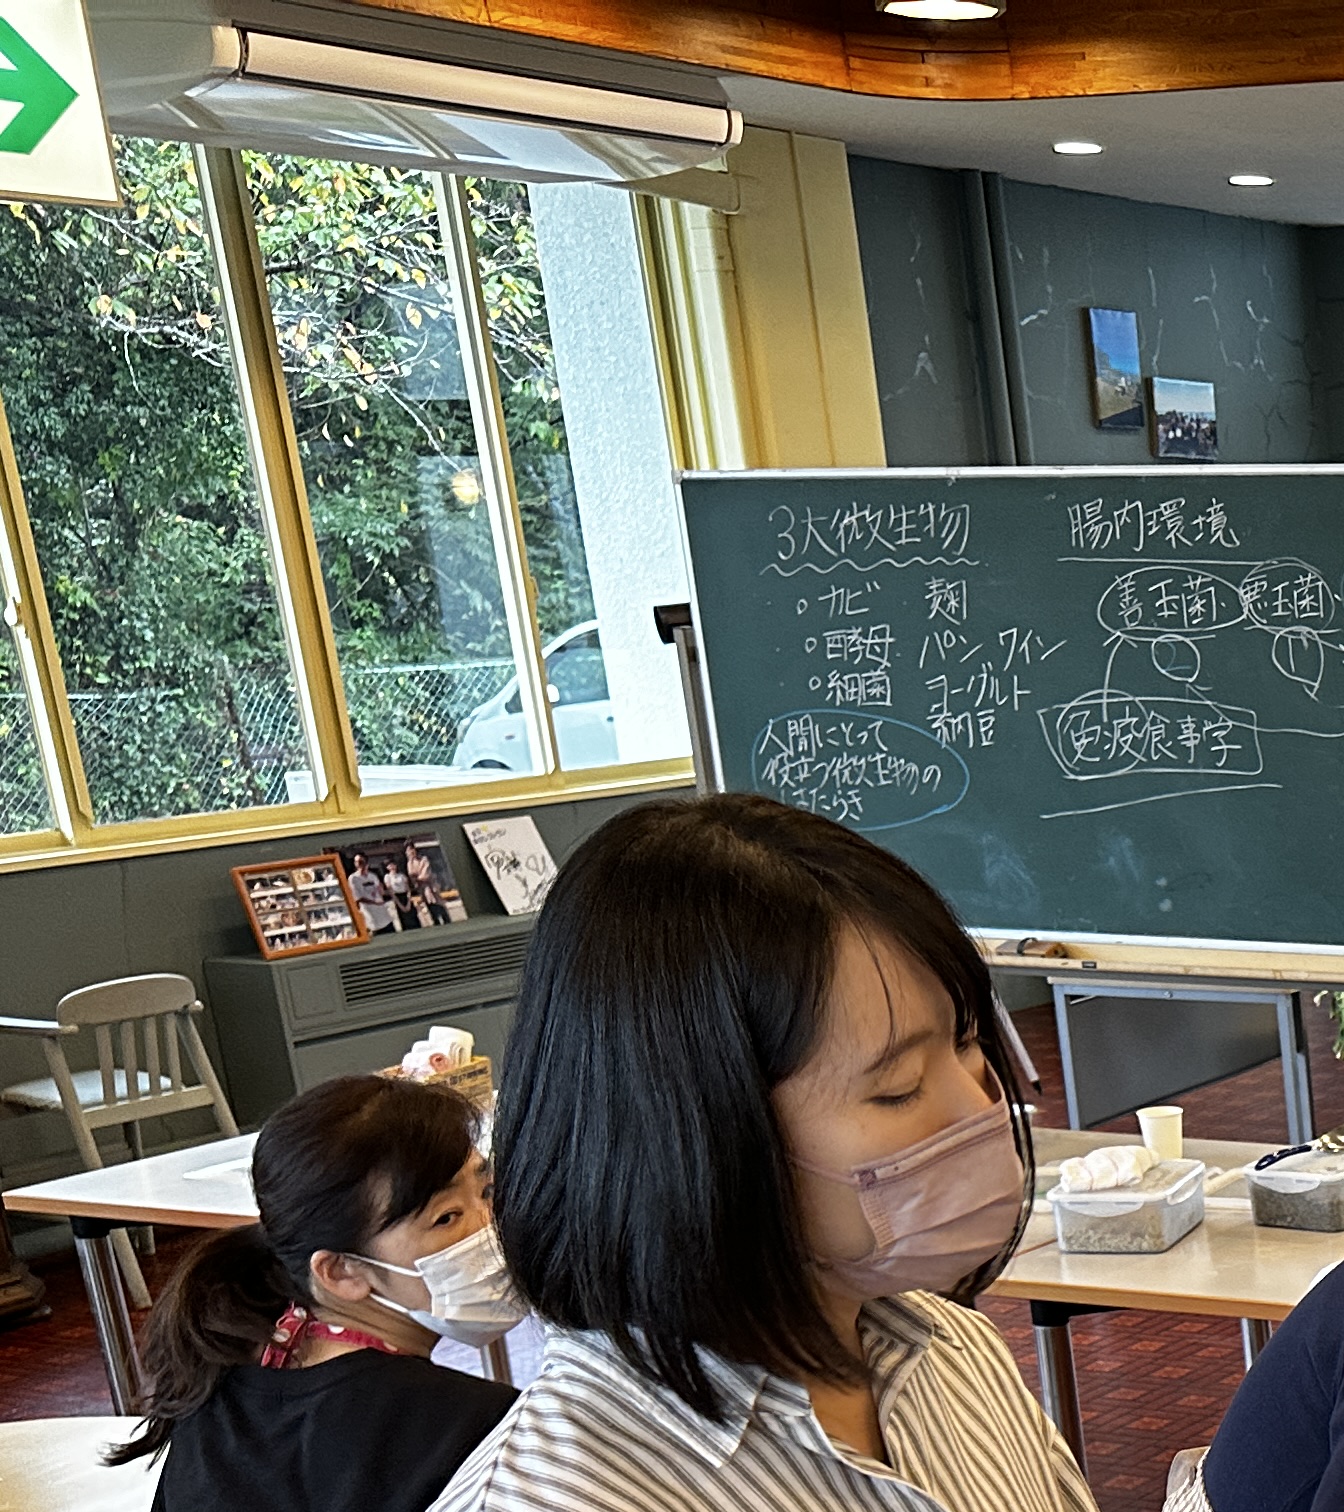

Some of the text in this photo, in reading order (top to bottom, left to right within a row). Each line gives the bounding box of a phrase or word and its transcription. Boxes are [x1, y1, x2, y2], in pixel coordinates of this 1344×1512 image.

[768, 502, 971, 560] 3大微生物
[1068, 498, 1239, 551] 腸内環境
[819, 581, 880, 618] カビ
[825, 624, 896, 668] 酵母
[826, 662, 1031, 711] 細菌 ヨーグルト
[759, 714, 889, 758] 人間にとって
[927, 709, 995, 748] 納豆
[1060, 708, 1242, 767] 免疫食事学
[762, 752, 941, 795] 役立つ微生物の
